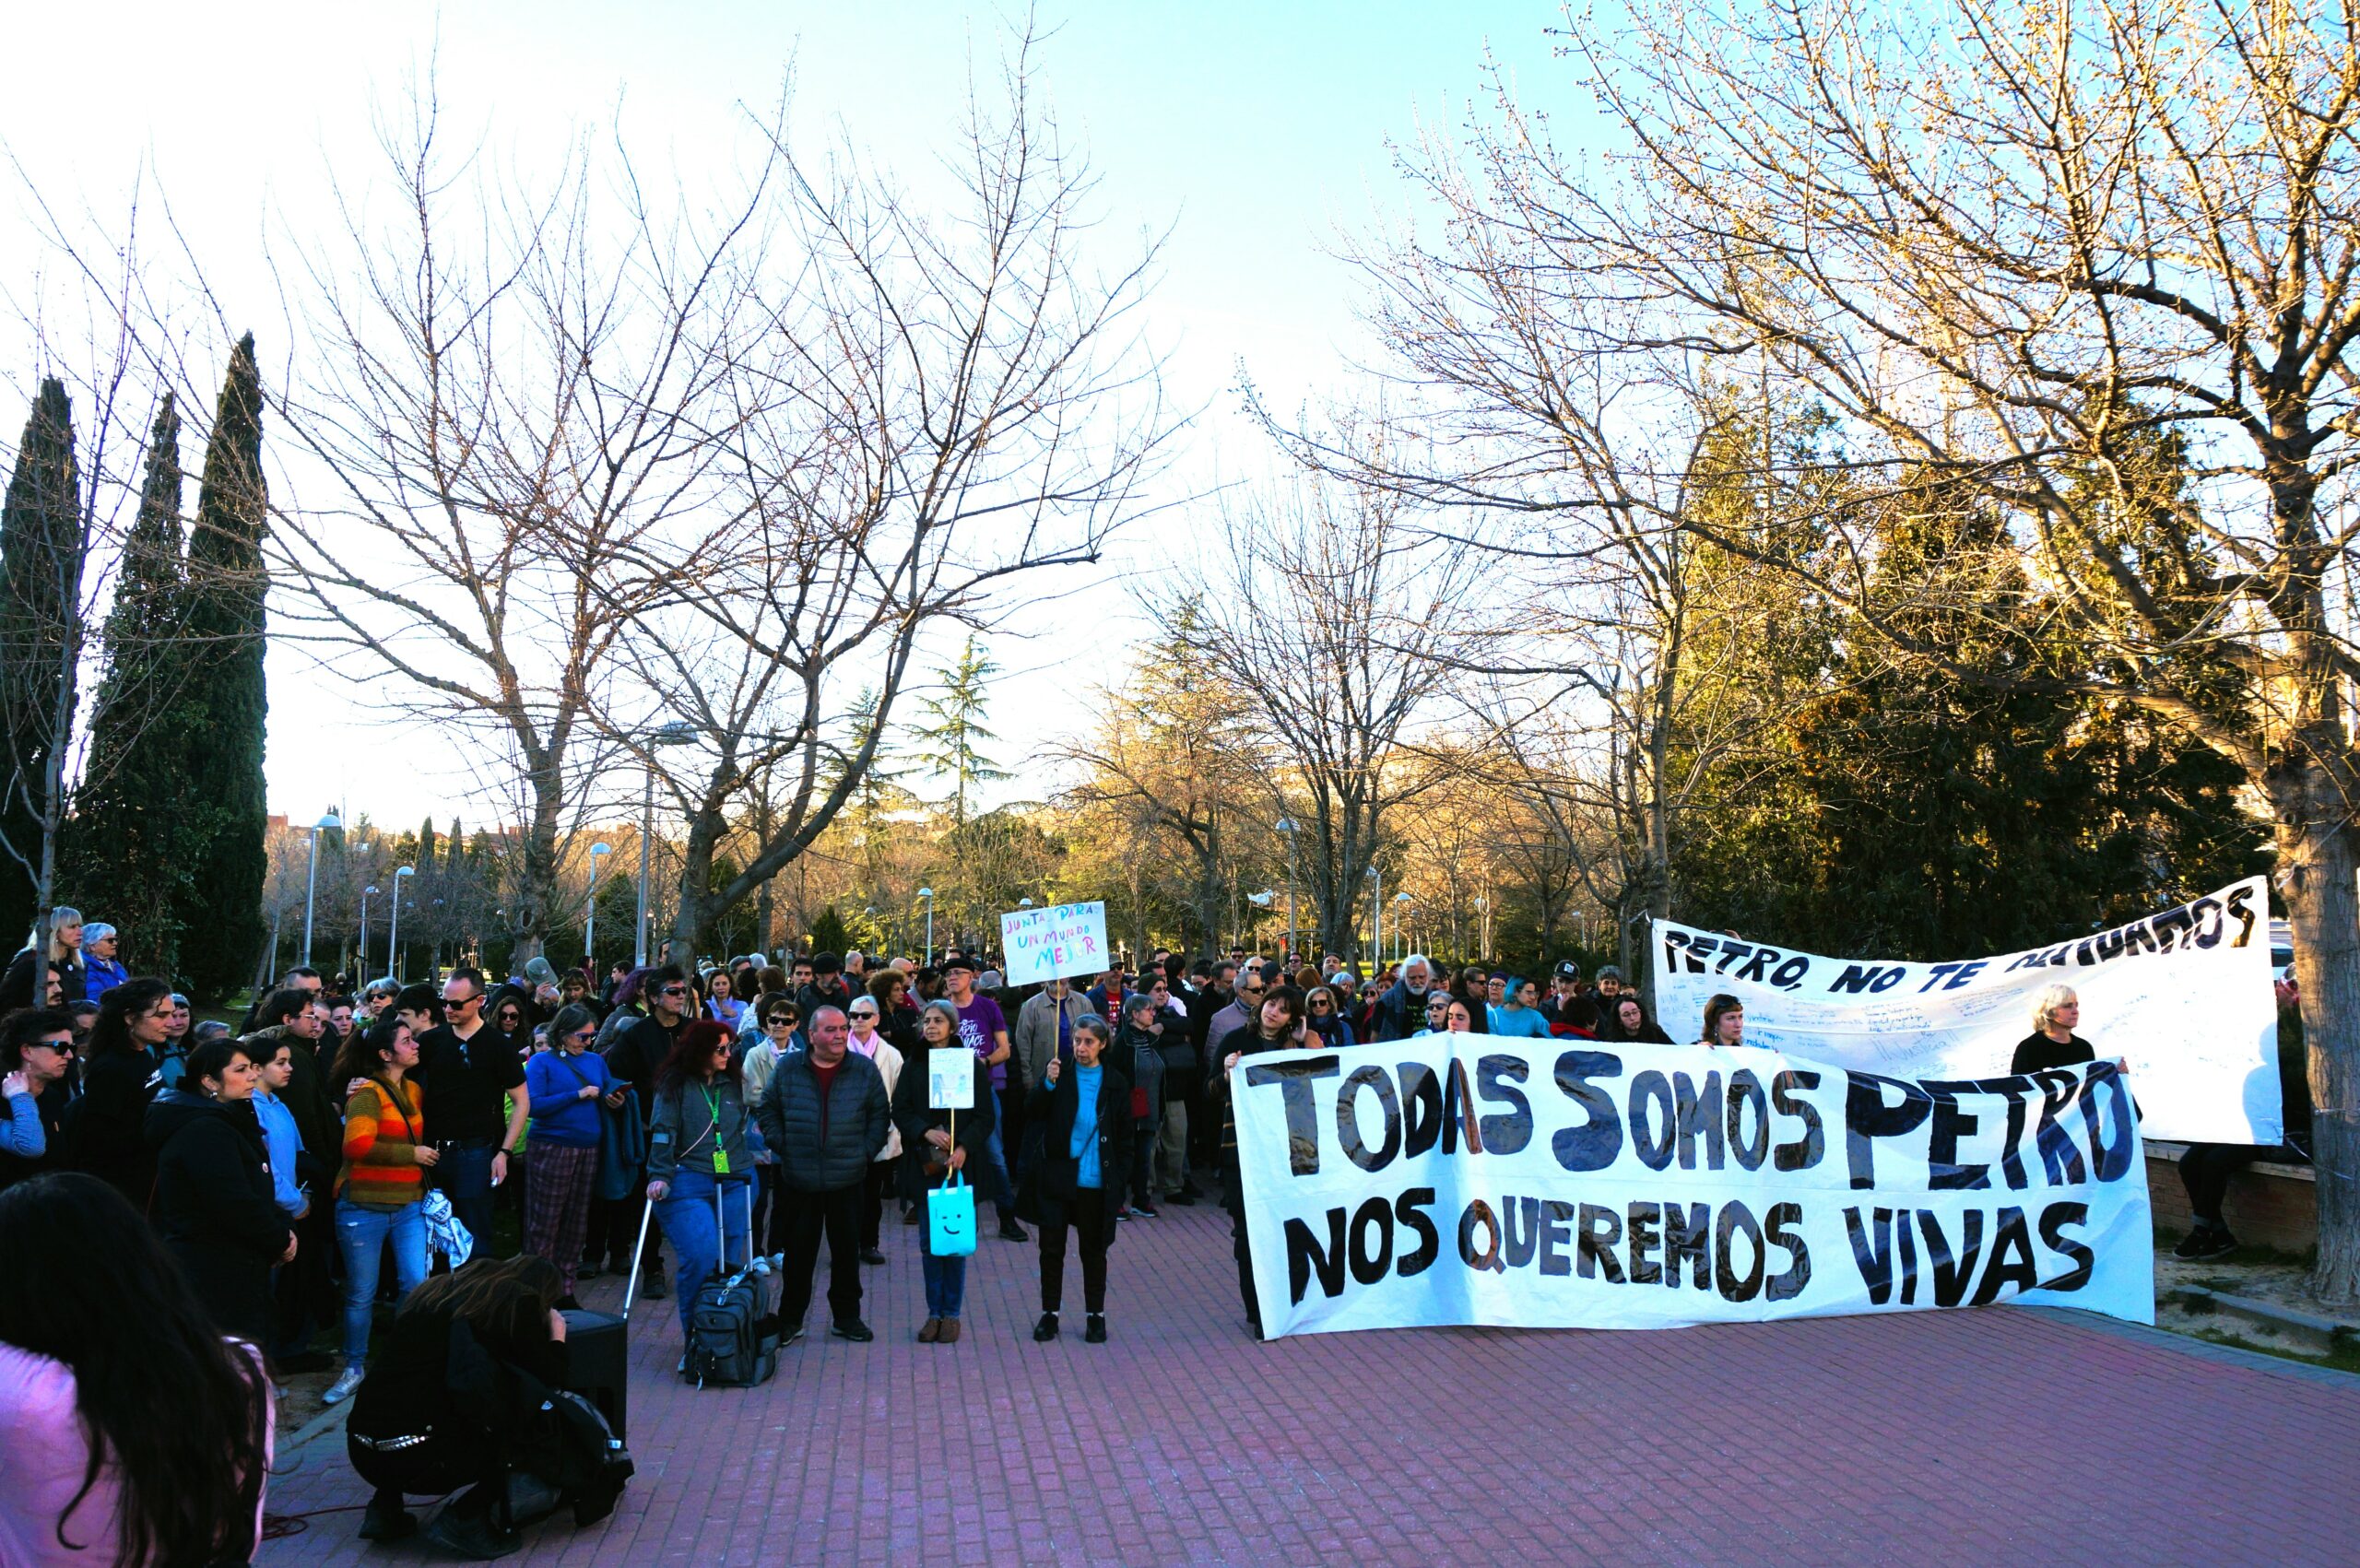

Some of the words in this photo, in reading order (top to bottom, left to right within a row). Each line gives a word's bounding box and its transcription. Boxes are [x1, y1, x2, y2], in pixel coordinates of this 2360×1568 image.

[1006, 911, 1054, 935] JUNTA
[1055, 903, 1093, 921] PARA
[1017, 934, 1039, 949] UN
[1044, 925, 1090, 944] MUNDO
[1034, 936, 1097, 970] MEJOR
[1665, 929, 1810, 992] PETRO,
[1828, 964, 1907, 994] NO
[1918, 961, 1991, 994] TE
[1245, 1053, 1534, 1177] TODAS
[1552, 1050, 1825, 1173] SOMOS
[1845, 1061, 2134, 1191] PETRO
[1282, 1186, 1439, 1307] NOS
[1457, 1195, 1812, 1303] QUEREMOS
[1841, 1200, 2094, 1307] VIVAS
